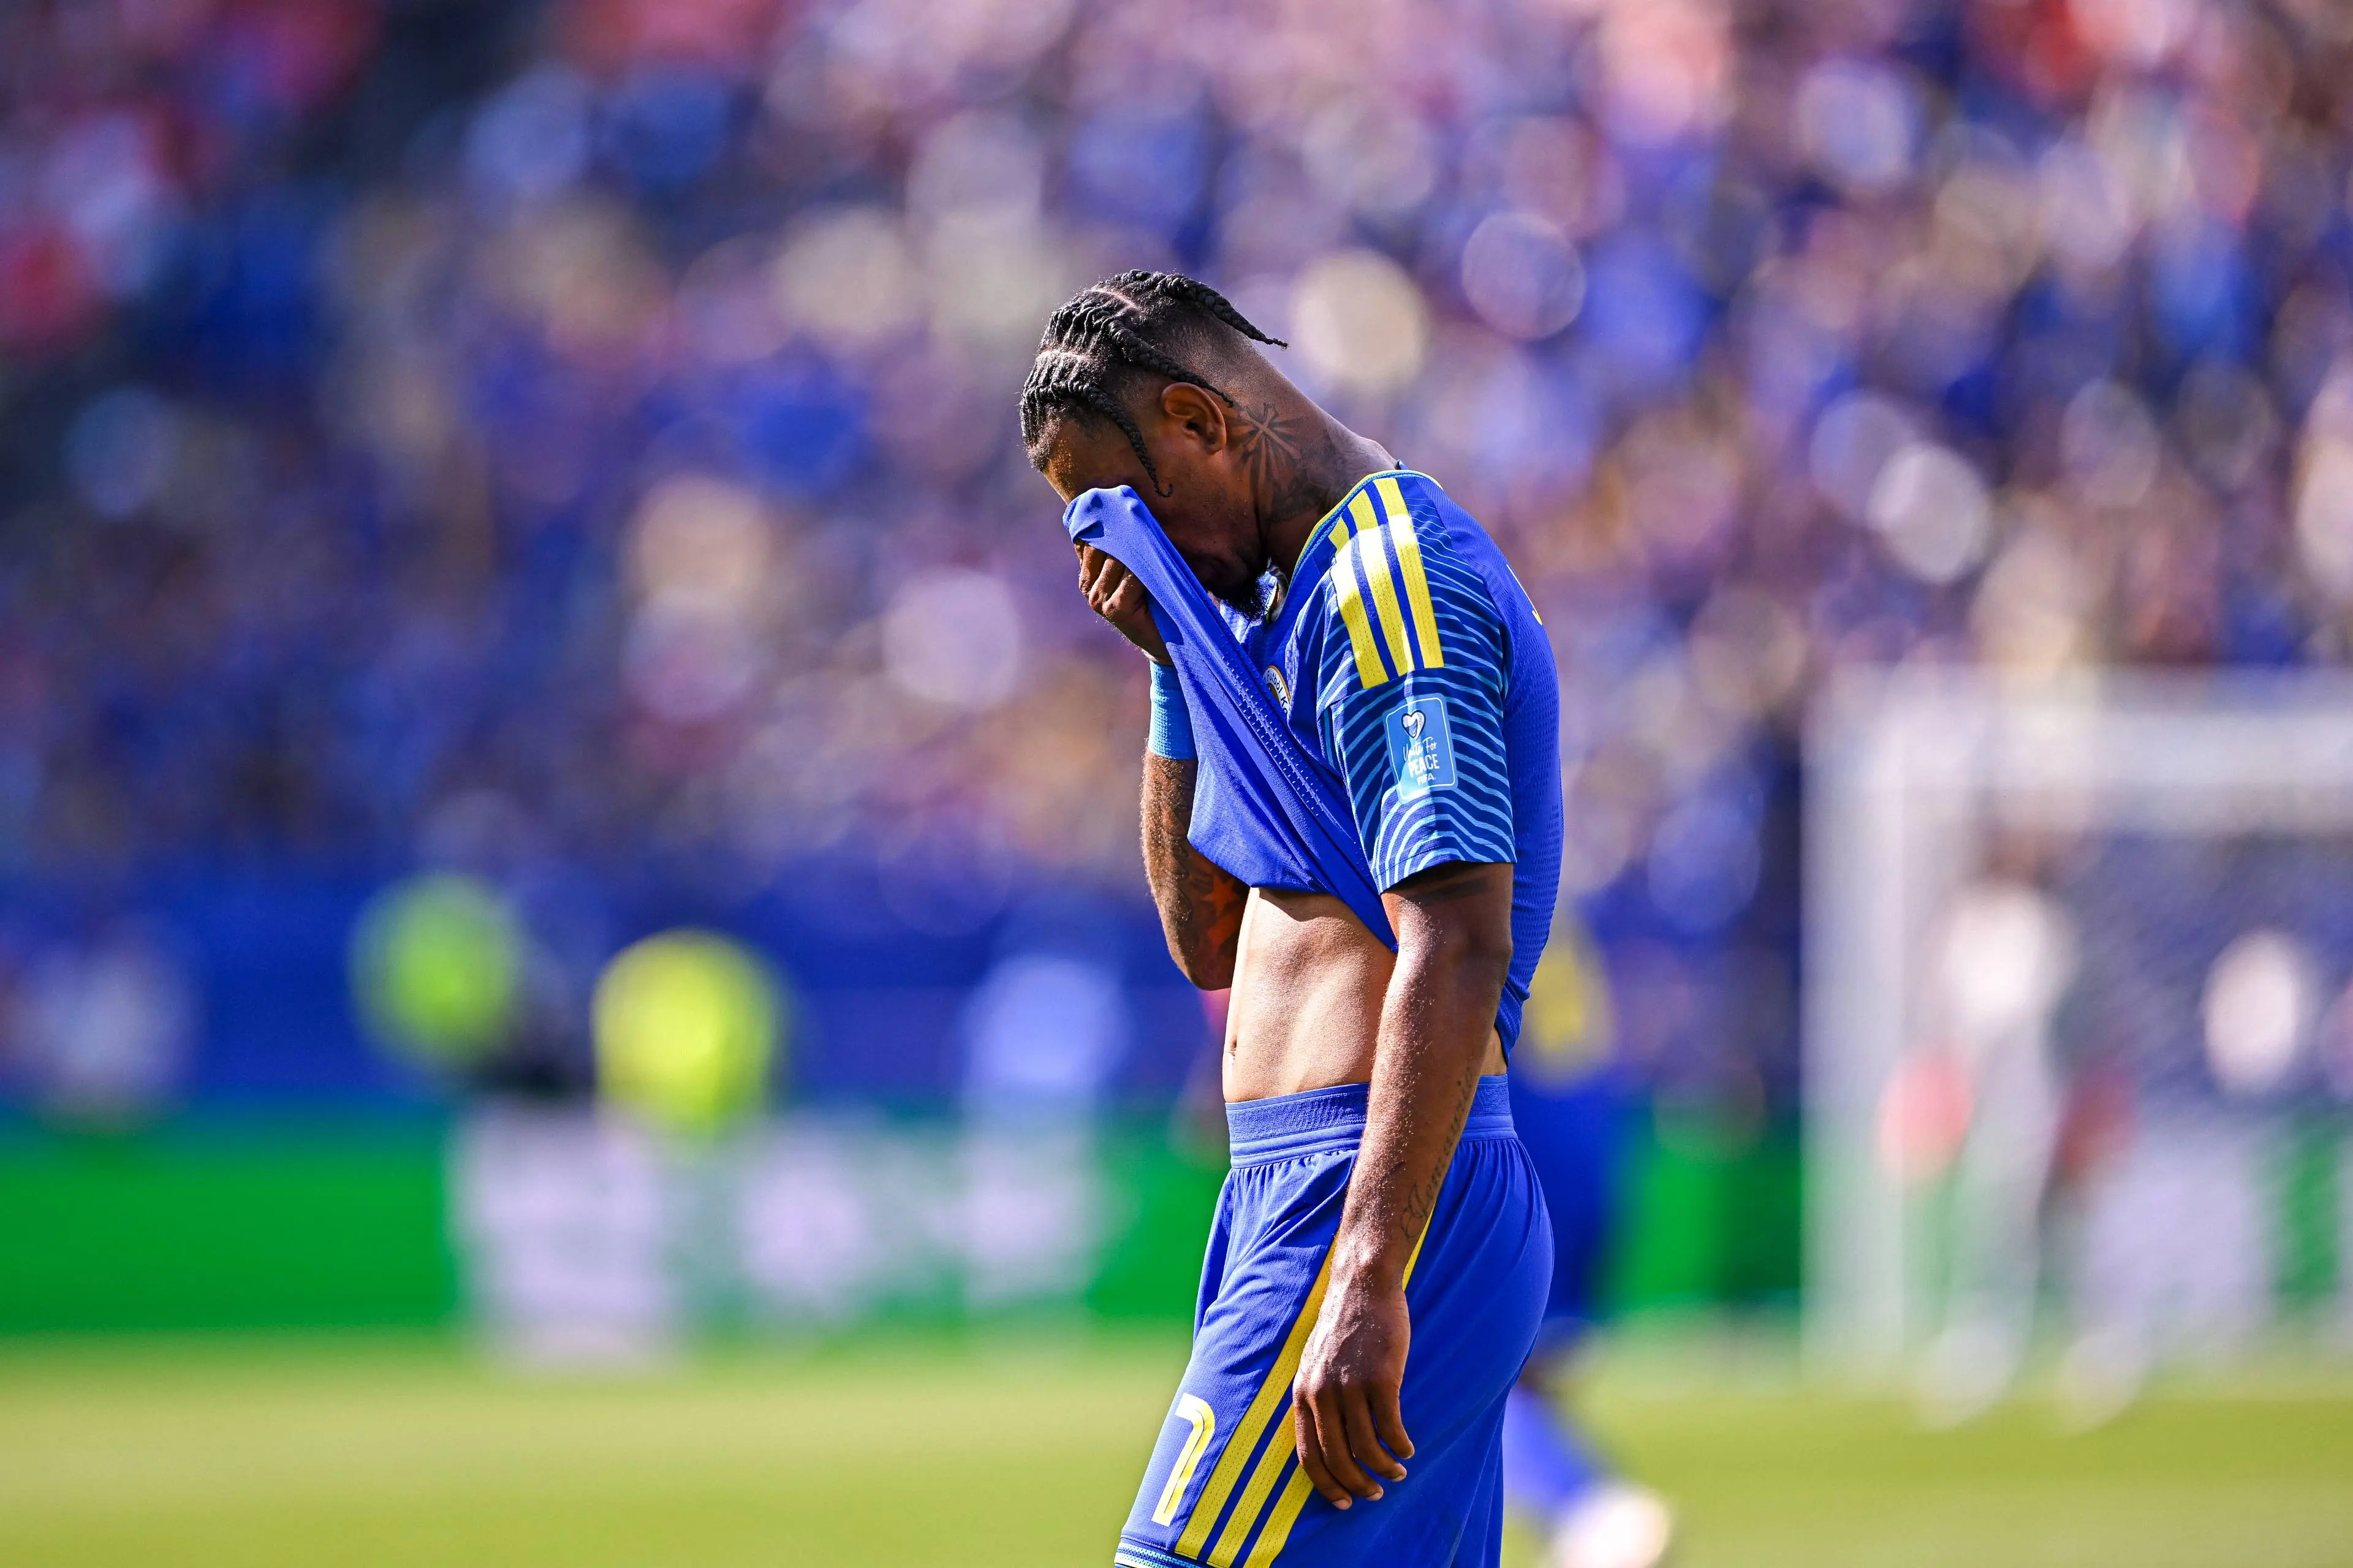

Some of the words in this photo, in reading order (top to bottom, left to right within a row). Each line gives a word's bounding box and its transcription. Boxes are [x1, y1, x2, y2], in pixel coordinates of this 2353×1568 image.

[1422, 737, 1438, 754] For
[1408, 754, 1440, 778] PEACE
[1151, 1392, 1215, 1527] 7
